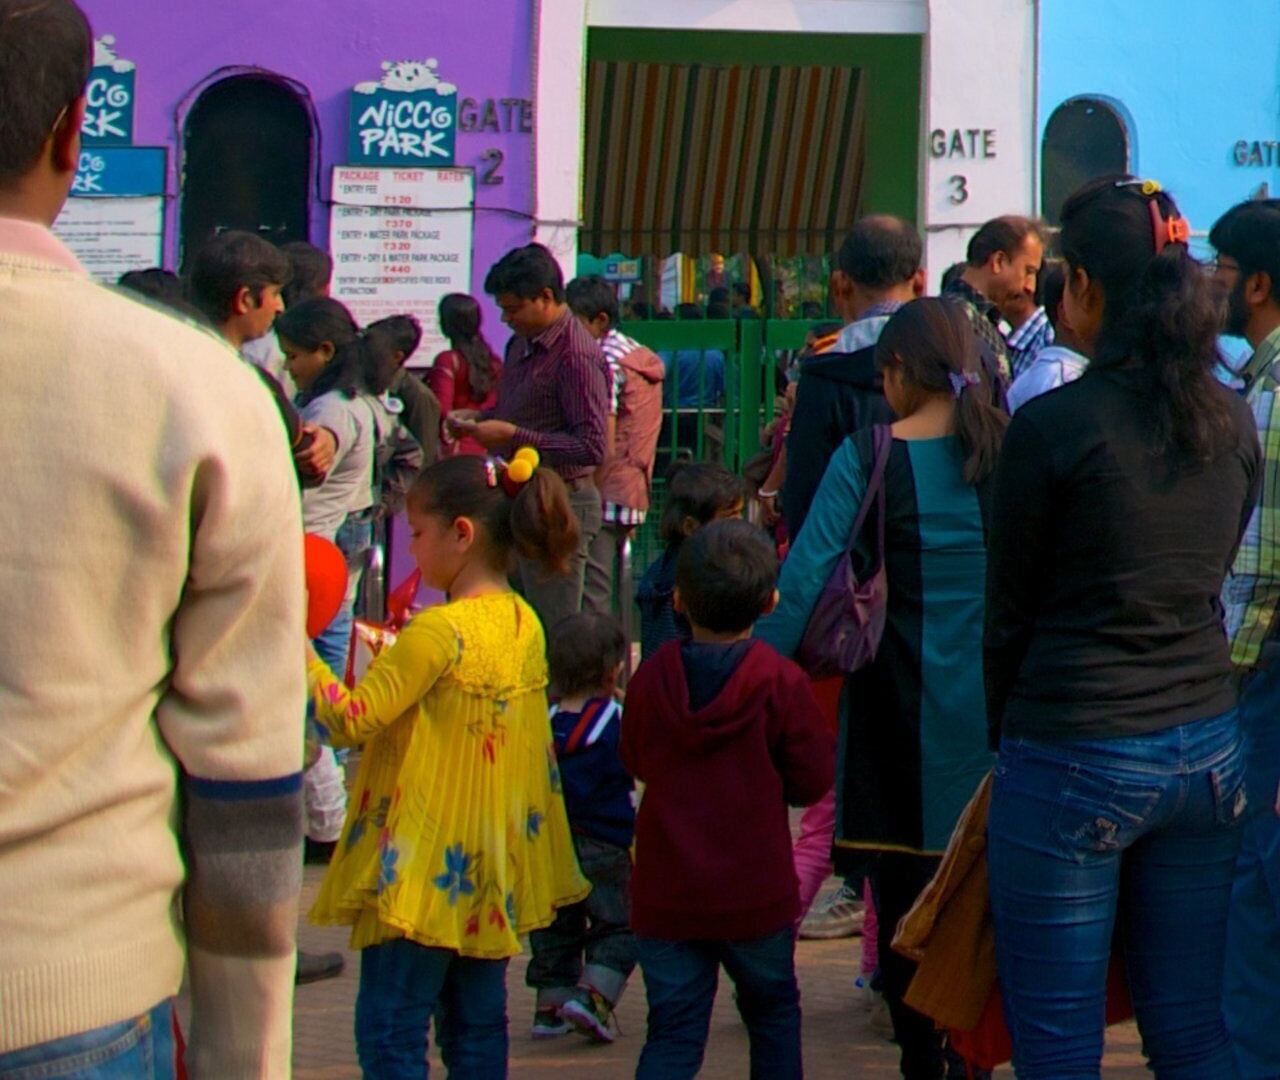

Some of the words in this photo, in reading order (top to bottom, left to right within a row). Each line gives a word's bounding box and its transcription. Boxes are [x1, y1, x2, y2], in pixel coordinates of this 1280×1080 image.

[457, 98, 533, 134] GATE
[360, 127, 449, 158] PARK
[930, 128, 996, 159] GATE
[339, 171, 380, 181] PACKAGE
[392, 171, 424, 181] TICKET
[437, 171, 464, 181] RATES
[482, 148, 505, 185] 2
[949, 174, 969, 205] 3
